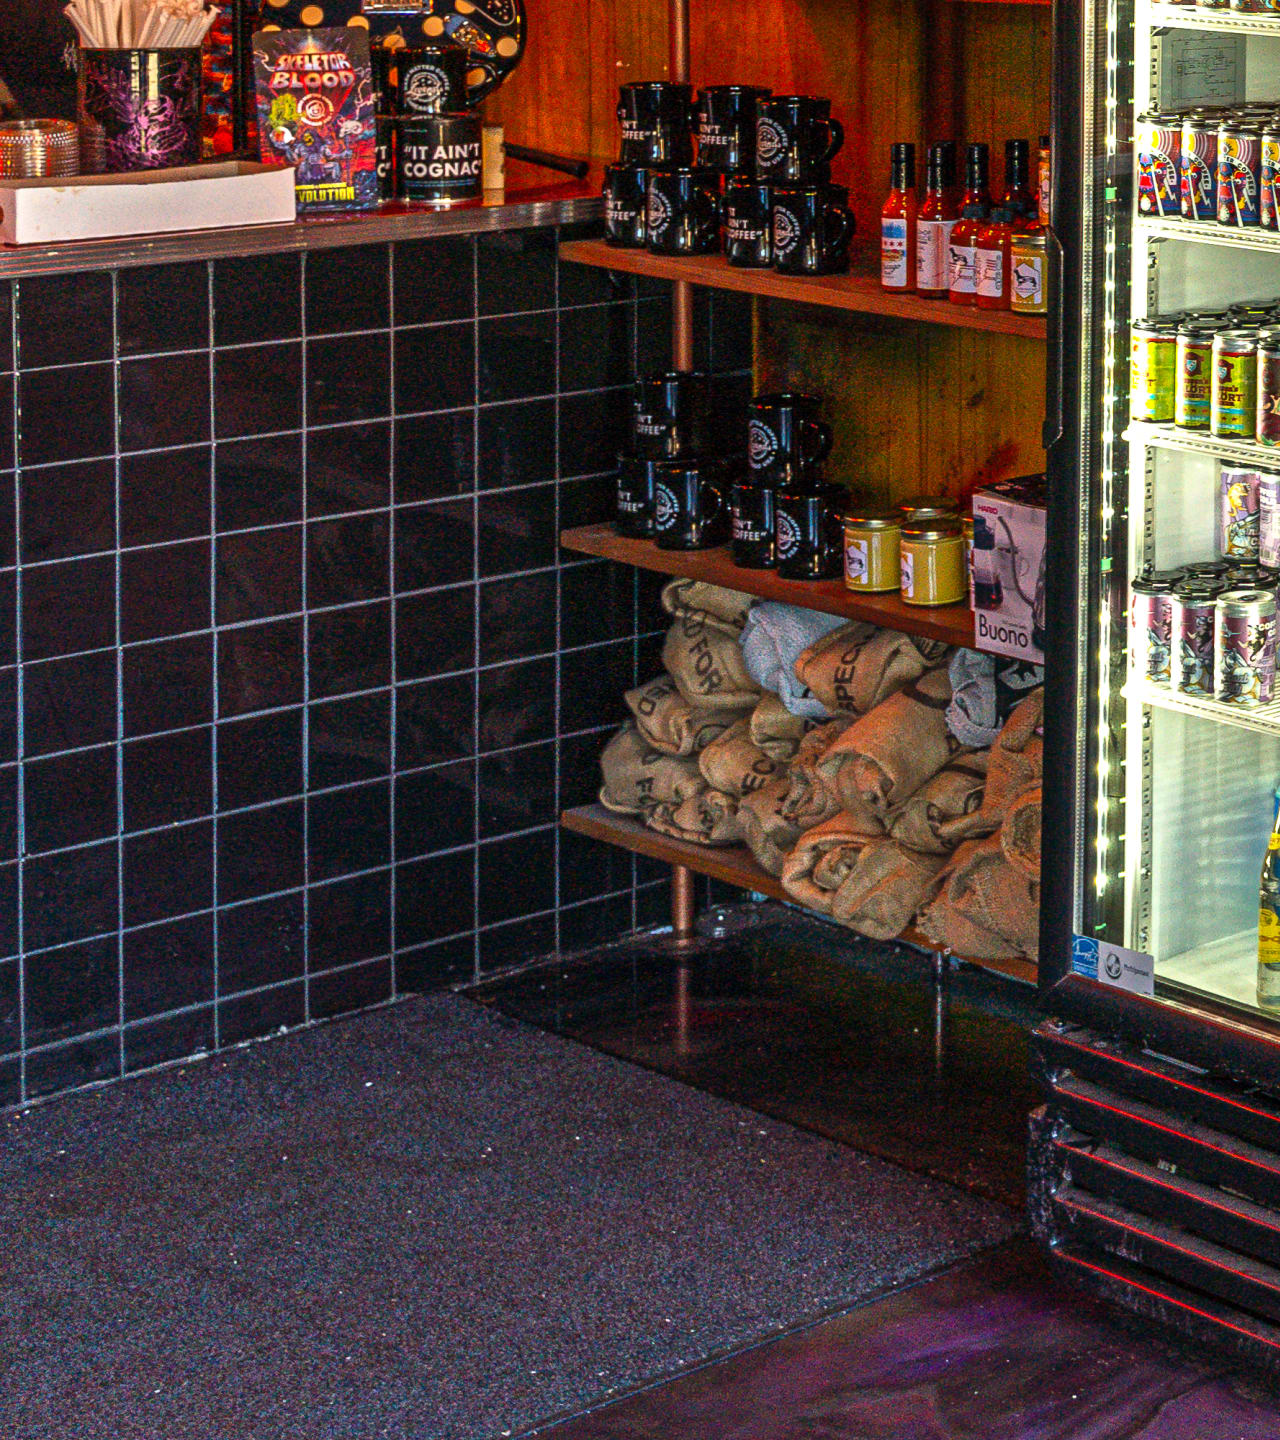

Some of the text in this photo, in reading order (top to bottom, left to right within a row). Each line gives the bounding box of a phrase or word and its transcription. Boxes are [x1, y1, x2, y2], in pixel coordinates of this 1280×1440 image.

[276, 53, 351, 71] SKELETOR
[271, 71, 356, 88] BLOOD
[404, 143, 480, 160] "IT AIN'T
[978, 614, 1029, 649] Buono
